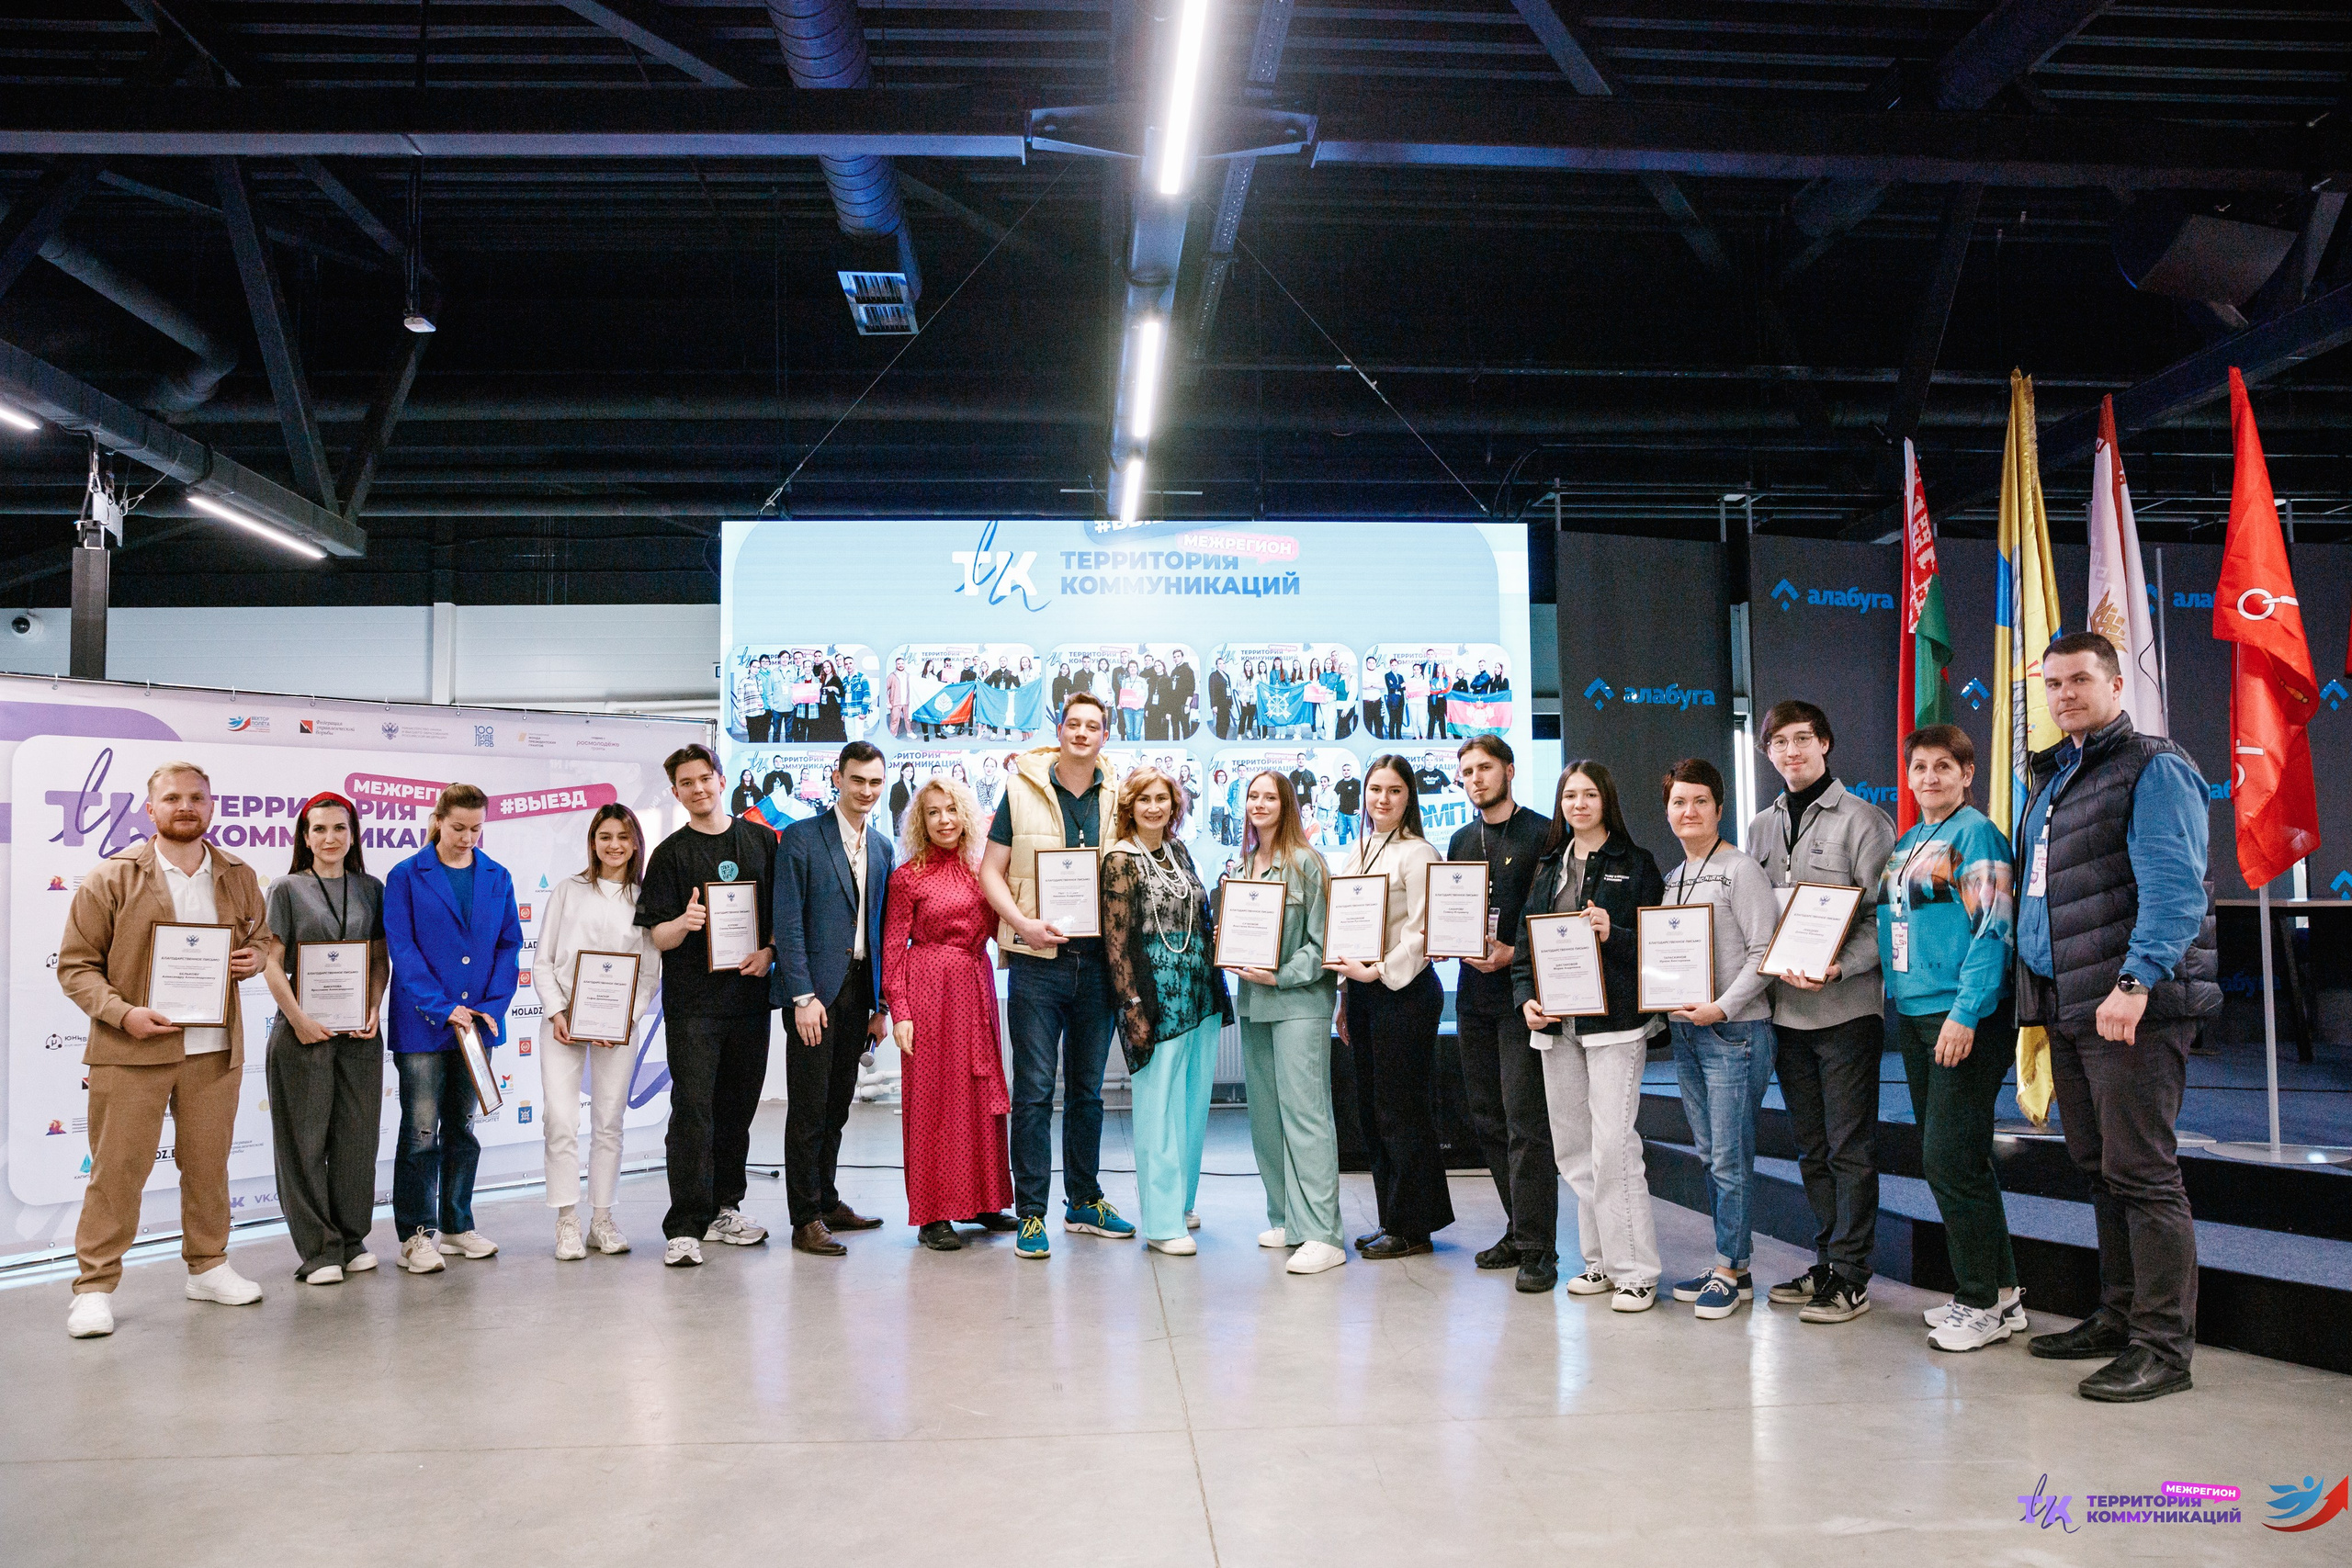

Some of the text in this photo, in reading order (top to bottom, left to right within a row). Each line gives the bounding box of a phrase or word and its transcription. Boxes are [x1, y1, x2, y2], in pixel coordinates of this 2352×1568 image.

[1183, 533, 1293, 556] МЕЖРЕГИОН
[1060, 550, 1238, 570] ТЕРРИТОРИЯ
[1060, 571, 1301, 598] КОММУНИКАЦИЙ
[1807, 586, 1894, 615] алабуга
[1623, 682, 1716, 711] алабуга
[500, 789, 588, 815] #ВЫЕЗД
